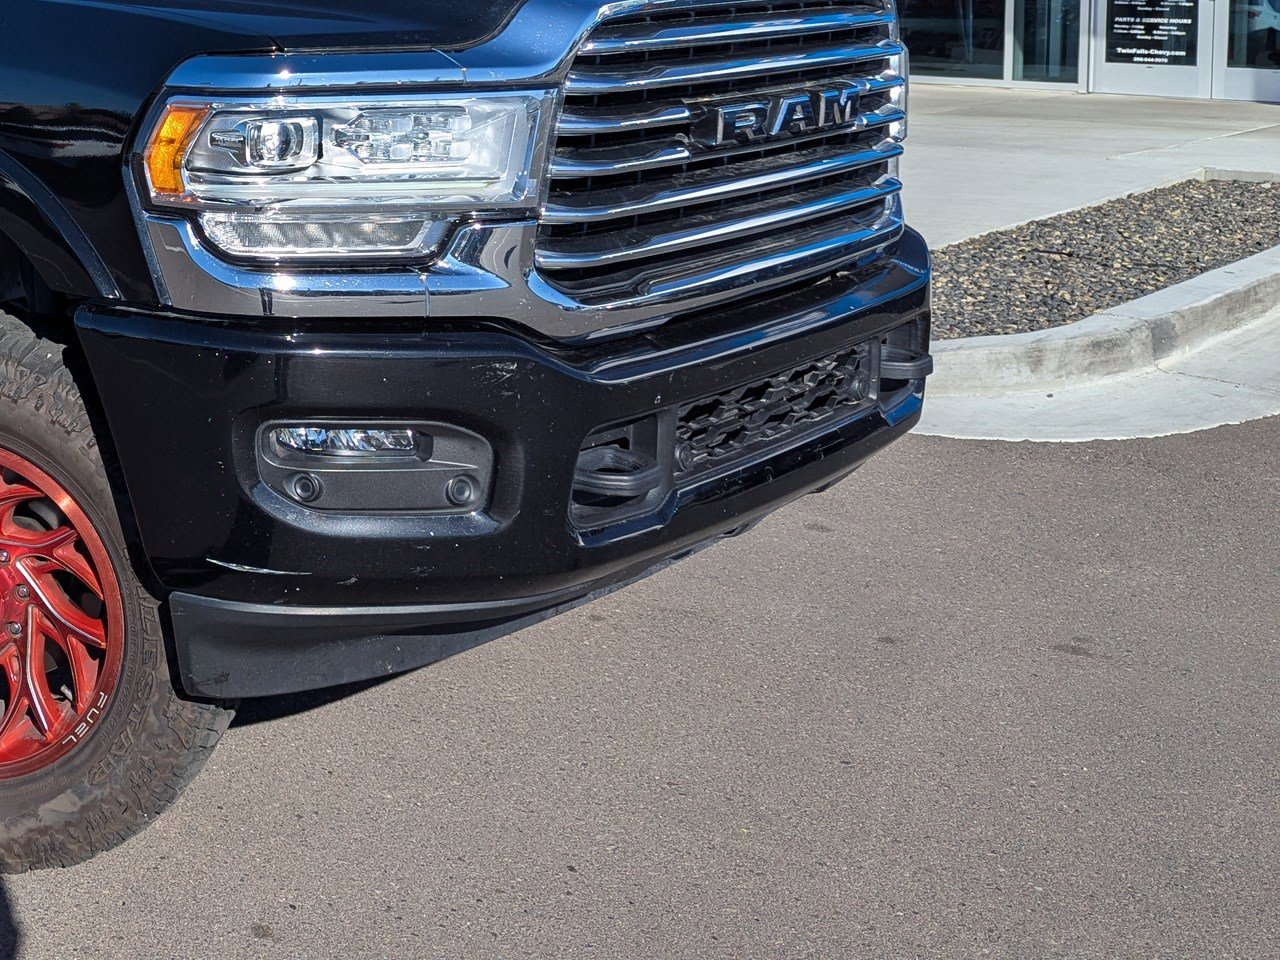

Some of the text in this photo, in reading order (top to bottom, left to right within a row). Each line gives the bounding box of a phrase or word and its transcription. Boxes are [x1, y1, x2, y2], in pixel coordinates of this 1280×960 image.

[1116, 47, 1186, 56] TwinFalls-Chevy.com
[716, 87, 859, 145] RAM
[61, 691, 109, 745] FUEL
